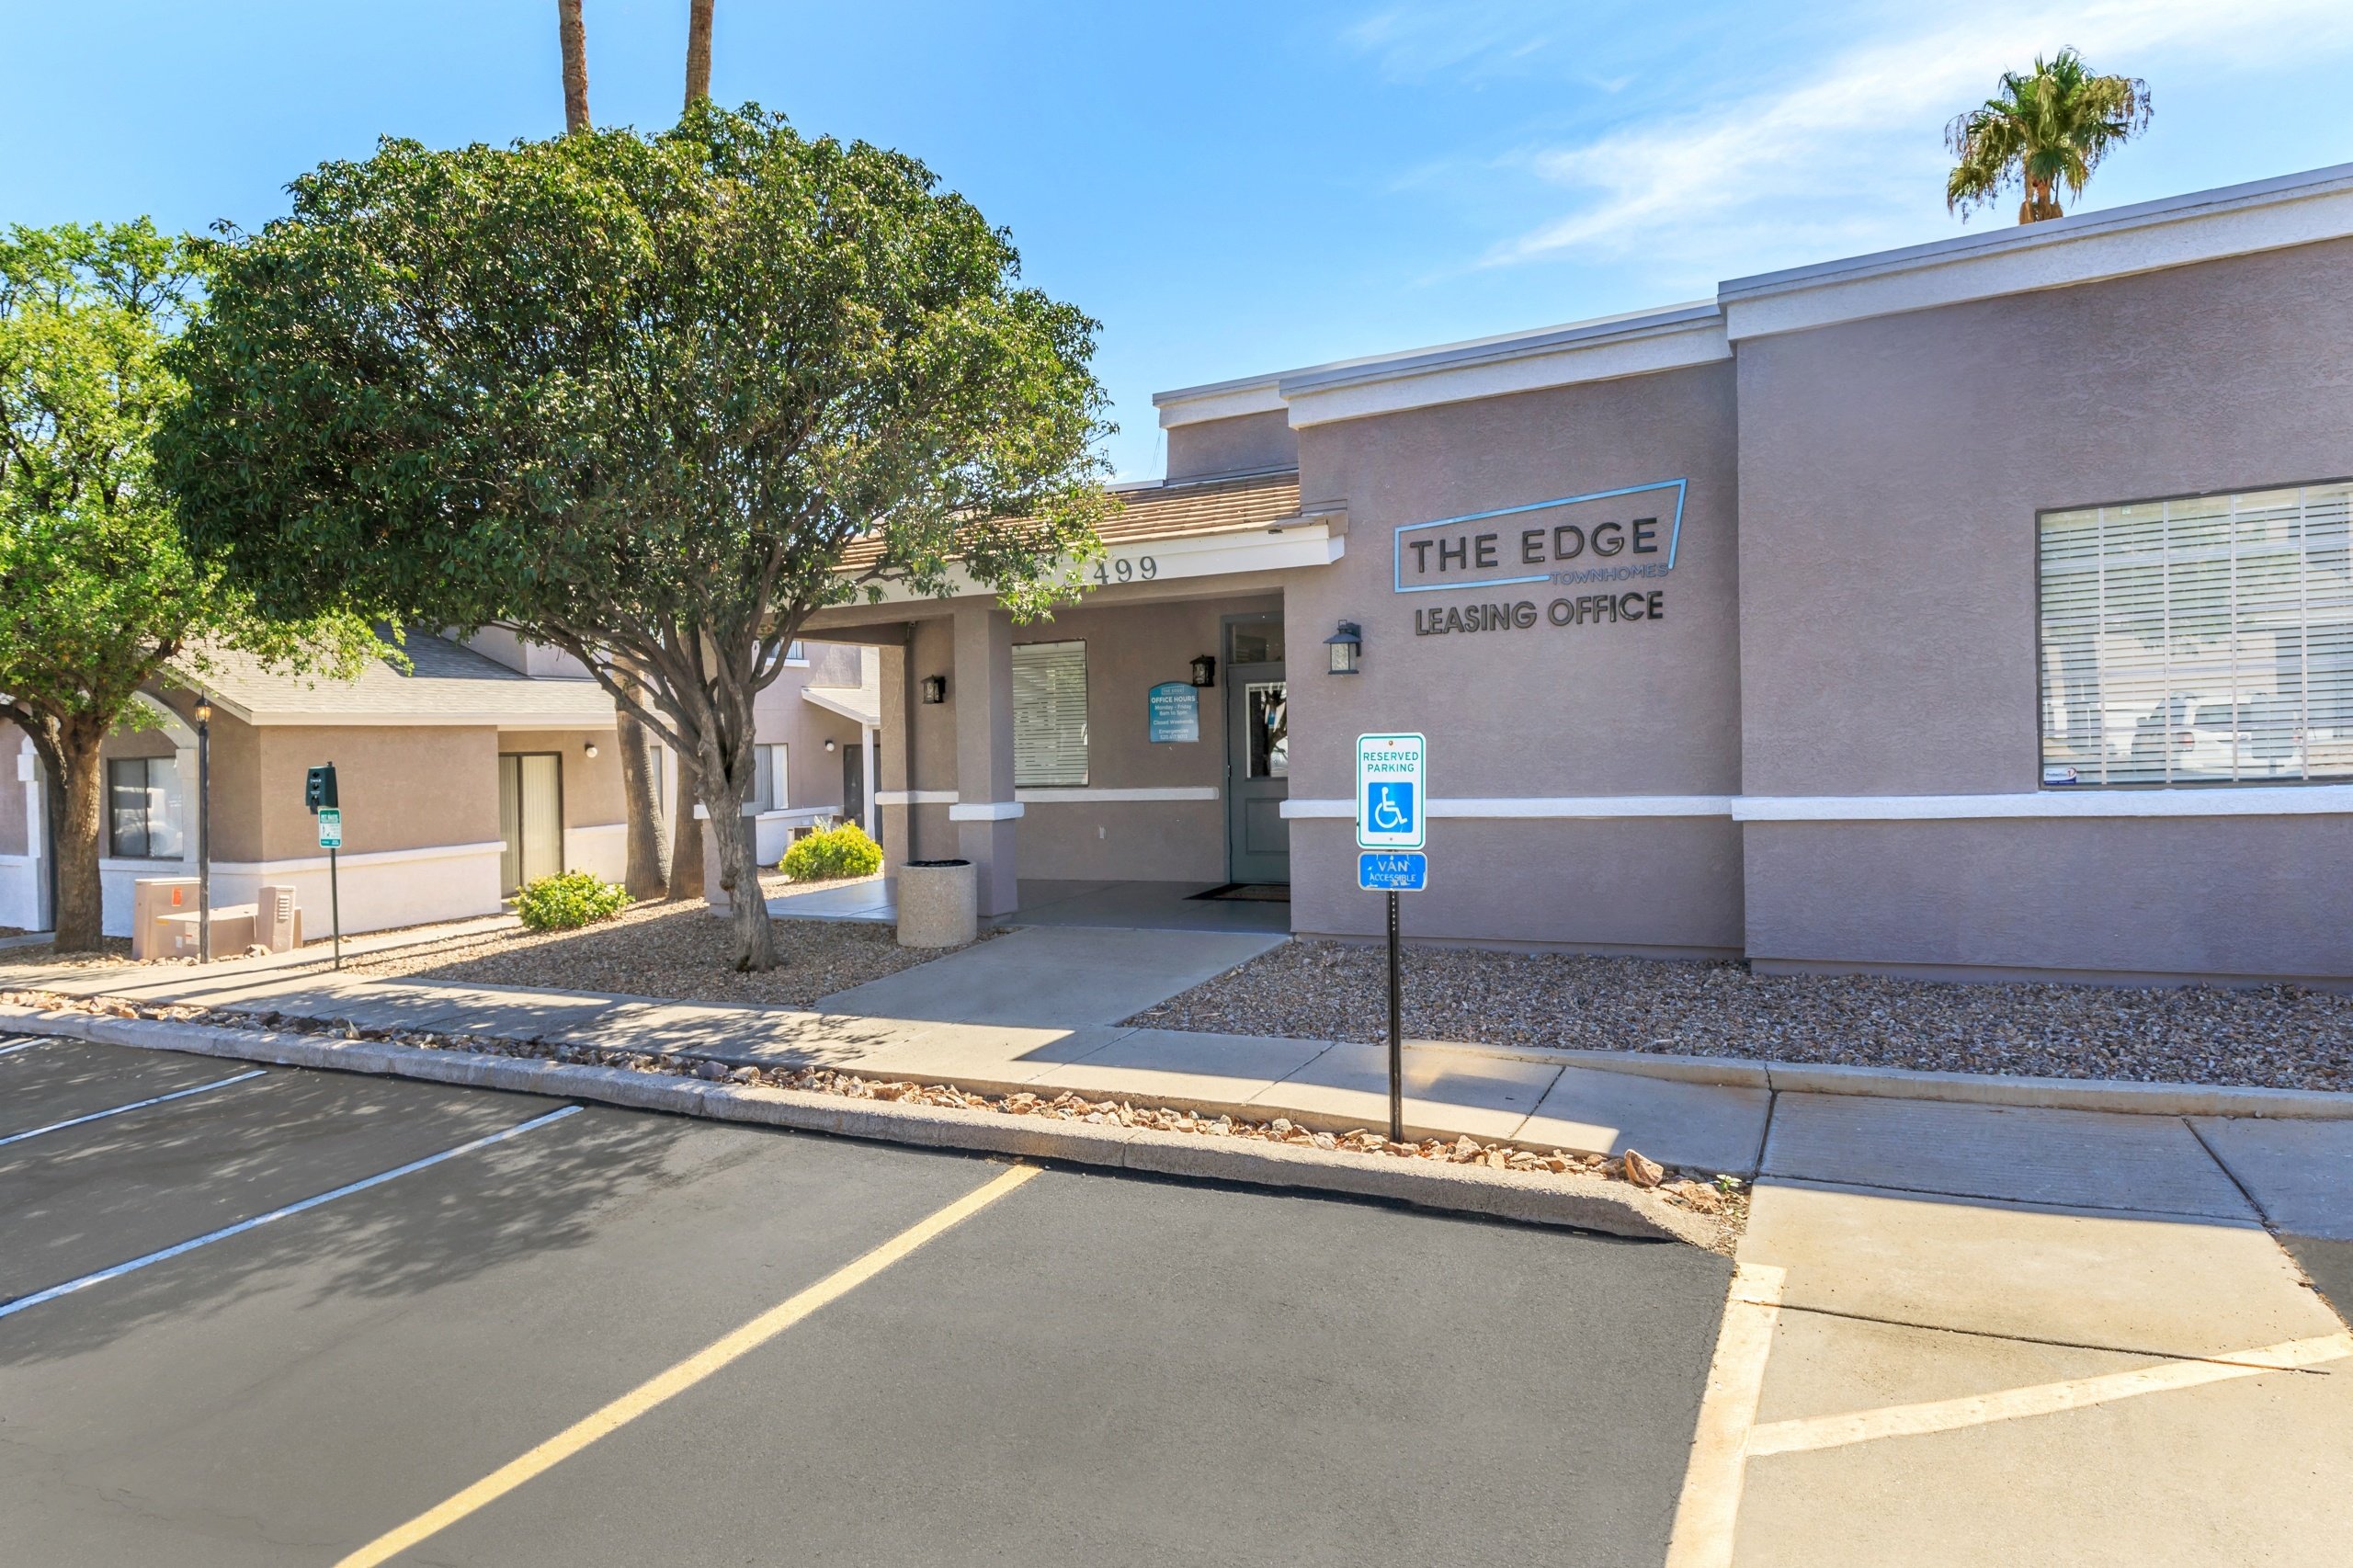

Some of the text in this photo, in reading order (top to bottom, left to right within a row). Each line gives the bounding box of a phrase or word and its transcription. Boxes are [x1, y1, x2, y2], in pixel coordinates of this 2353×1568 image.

[1410, 517, 1658, 573] THE EDGE
[1551, 563, 1669, 585] TOWNHOMES
[1415, 591, 1664, 635] LEASING OFFICE
[1363, 752, 1419, 761] RESERVED
[1367, 763, 1415, 773] PARKING
[1378, 860, 1409, 872] VAN
[1369, 873, 1416, 882] ACCESSIBLE
